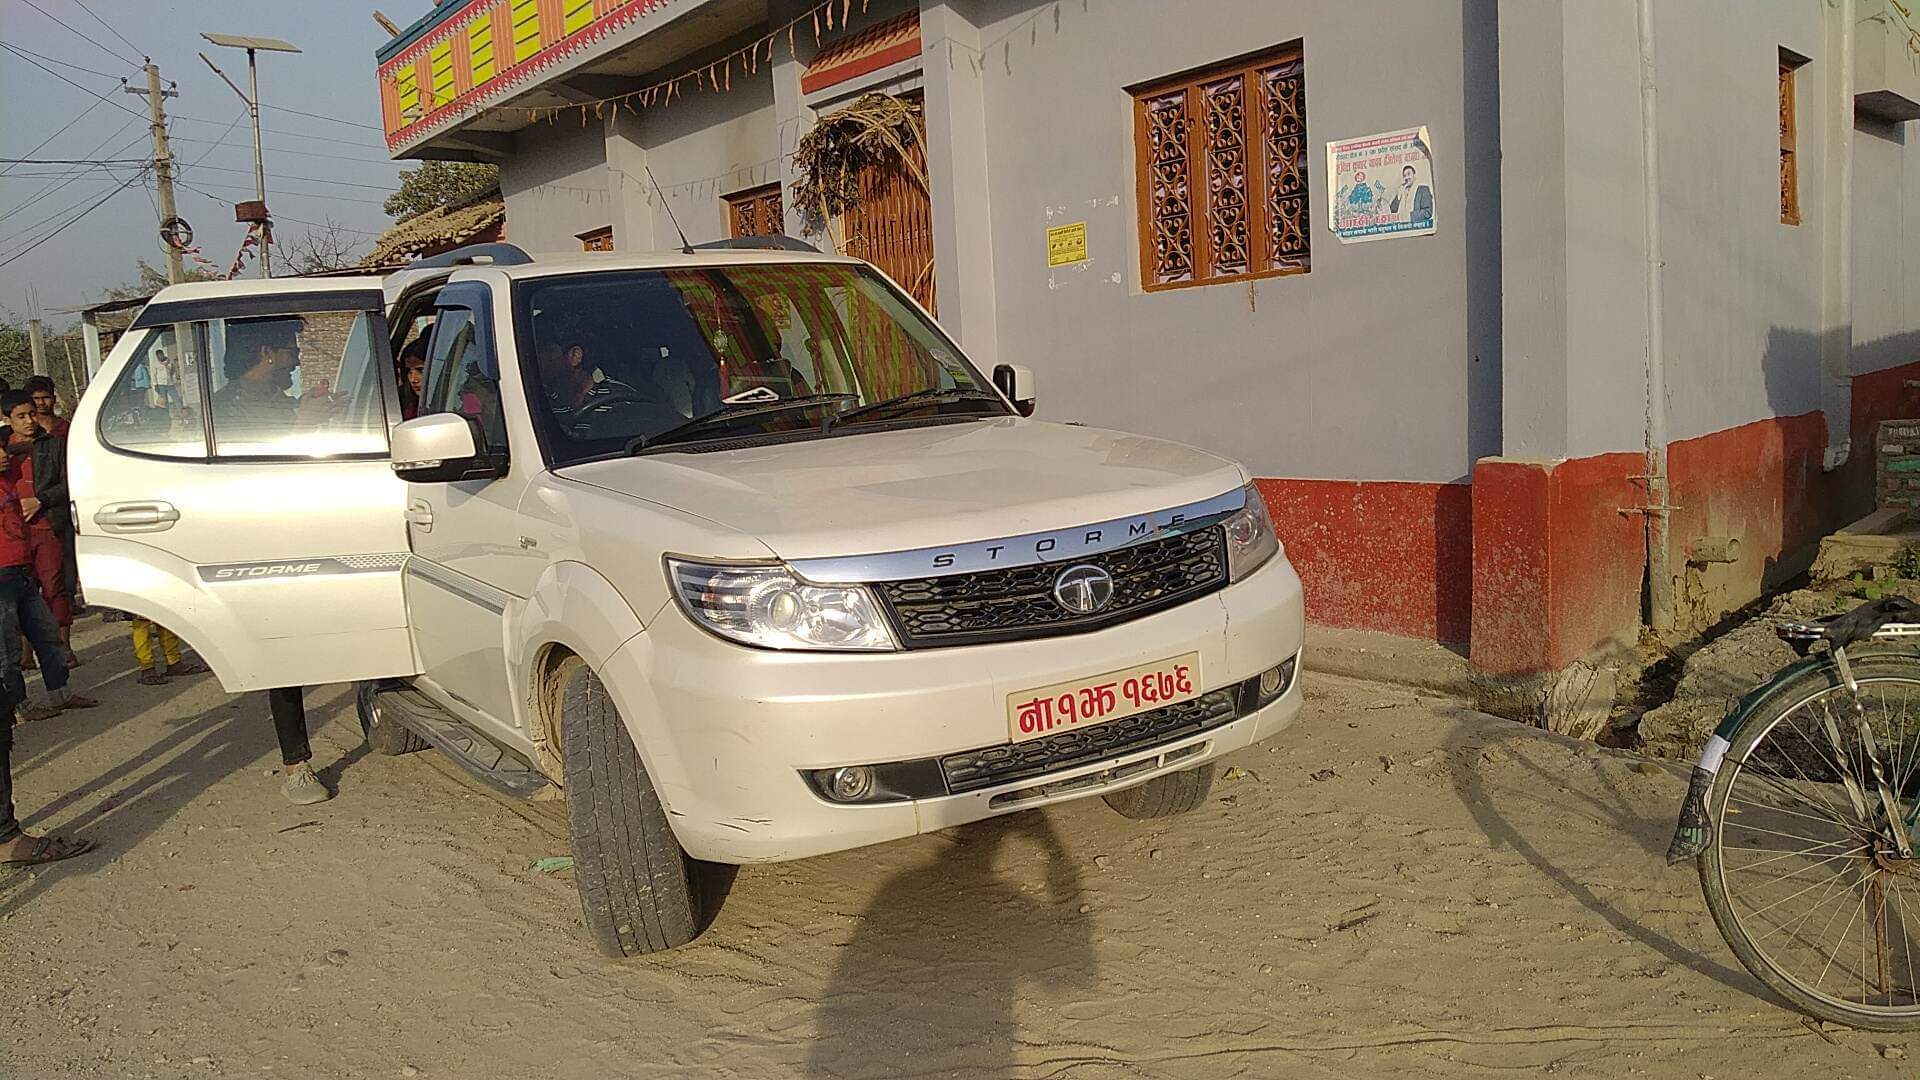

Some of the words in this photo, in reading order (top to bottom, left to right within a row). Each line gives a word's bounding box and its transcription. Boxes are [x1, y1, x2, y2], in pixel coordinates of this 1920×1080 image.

[932, 514, 1186, 568] STORME
[215, 563, 321, 578] STORME
[1122, 666, 1193, 708] १६७६
